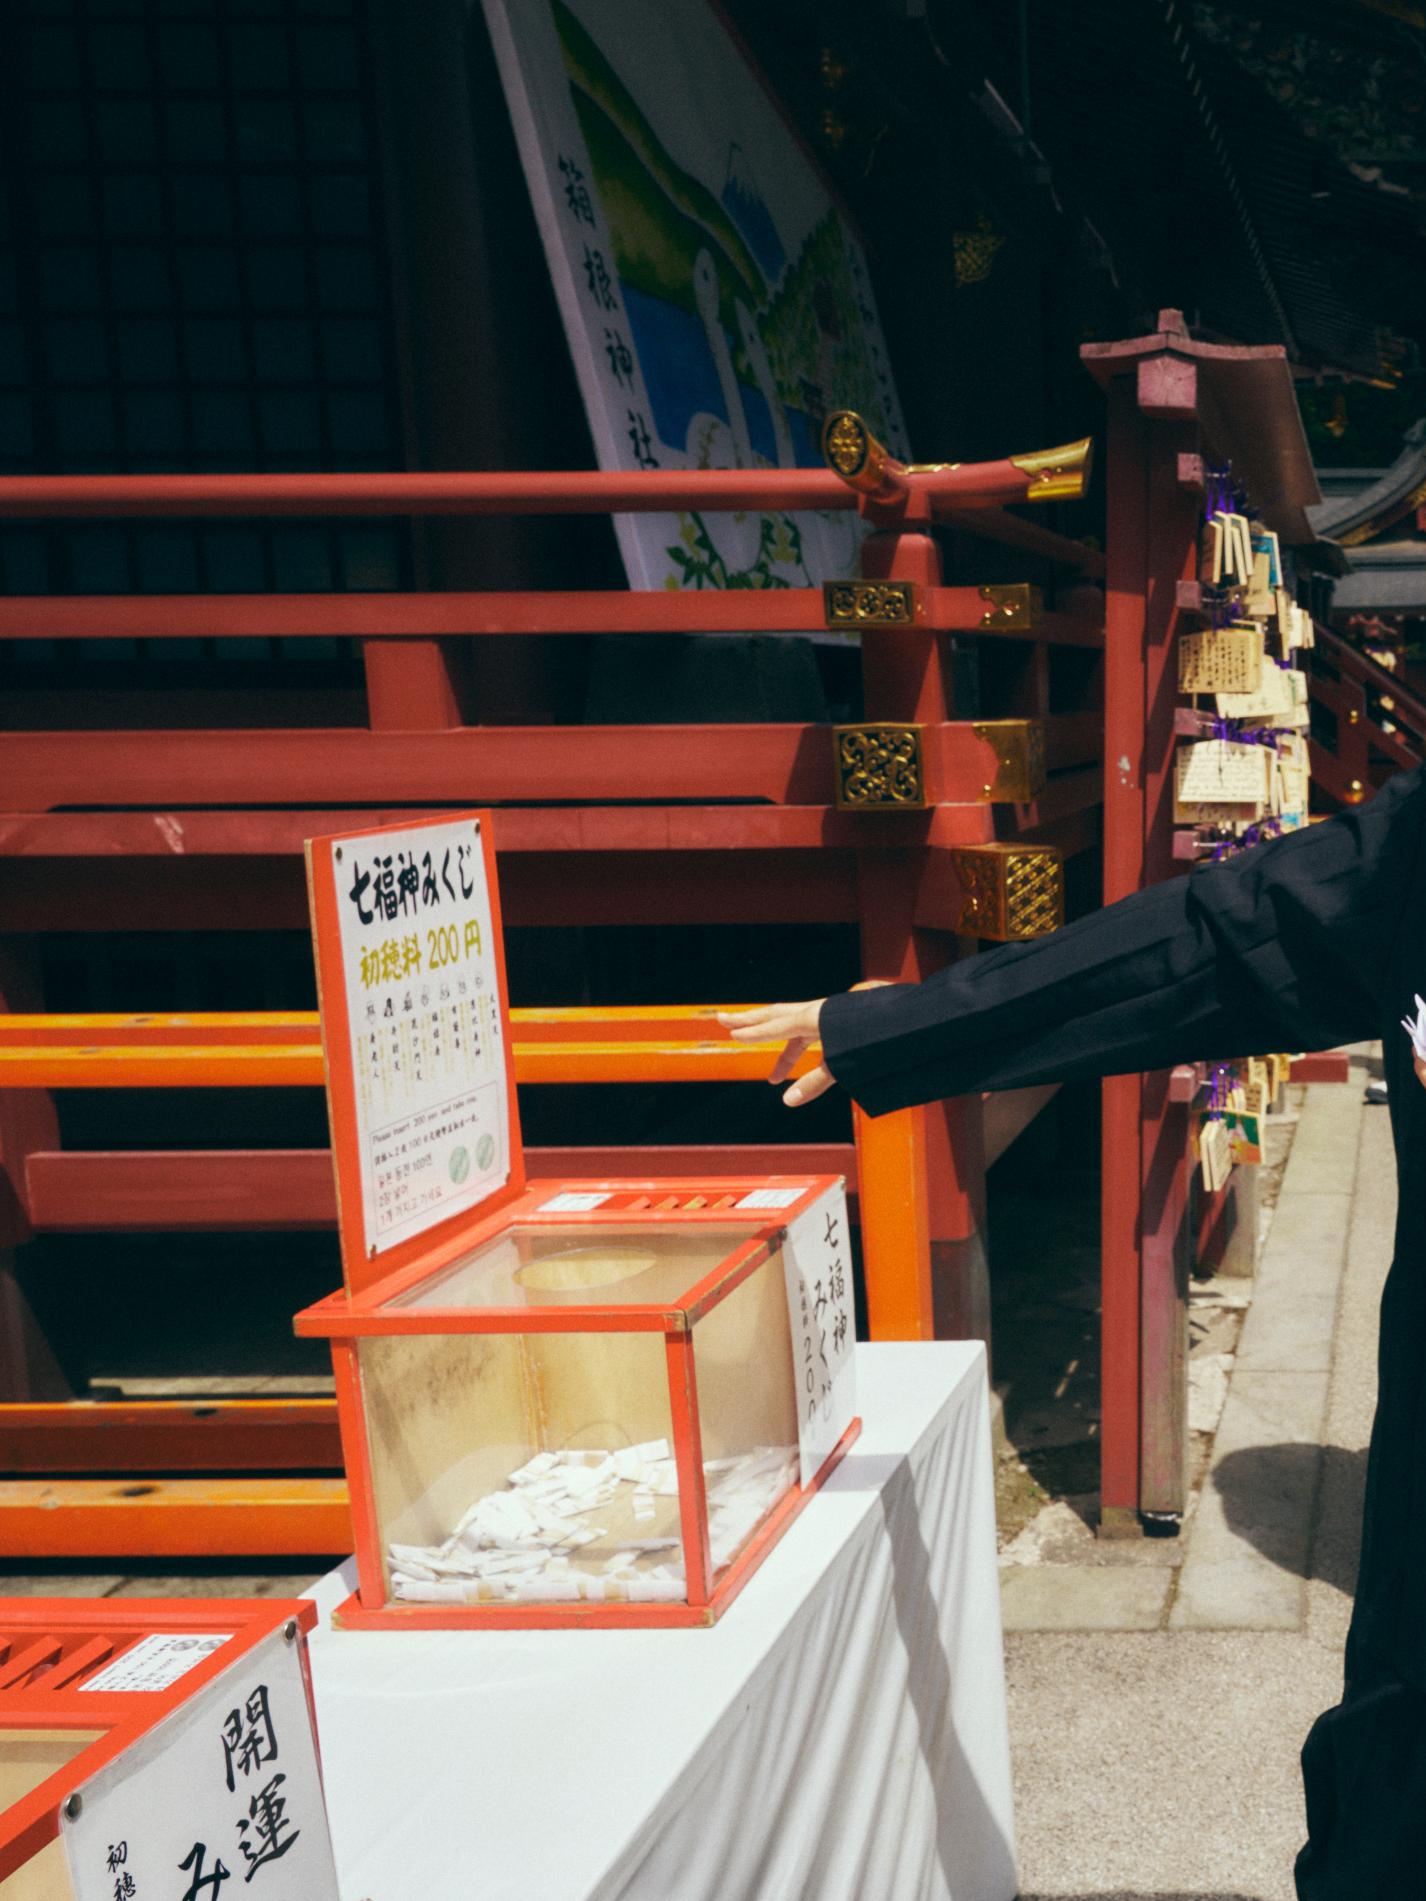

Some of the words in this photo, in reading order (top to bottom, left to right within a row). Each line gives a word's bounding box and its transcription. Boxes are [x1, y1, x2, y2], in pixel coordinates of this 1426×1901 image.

[558, 154, 660, 470] 箱根神社
[349, 845, 473, 925] 七福神みくじ
[824, 1211, 847, 1353] 七福神
[221, 1684, 300, 1883] 開運
